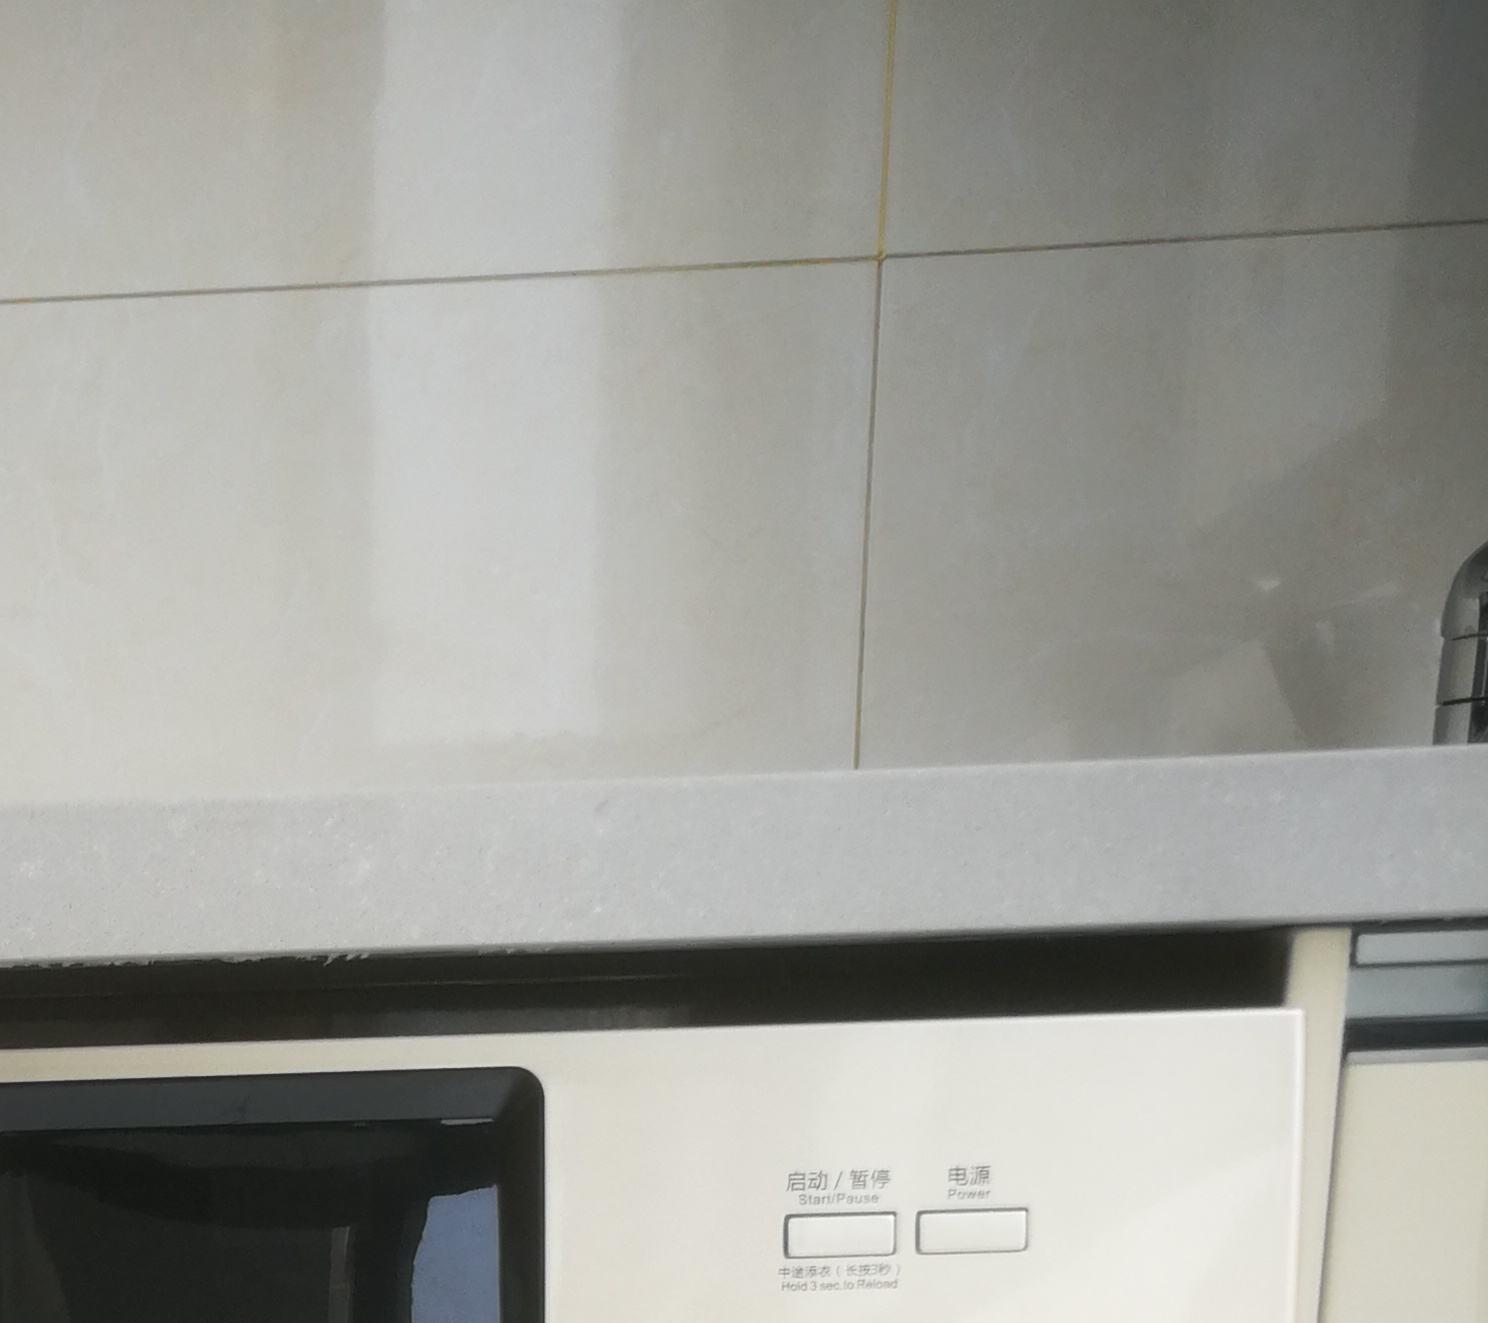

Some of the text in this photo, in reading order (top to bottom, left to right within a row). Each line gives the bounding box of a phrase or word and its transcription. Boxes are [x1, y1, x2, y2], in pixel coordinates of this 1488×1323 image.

[948, 1165, 992, 1186] 电源
[798, 1193, 880, 1206] Start/Pause
[947, 1189, 991, 1200] Power
